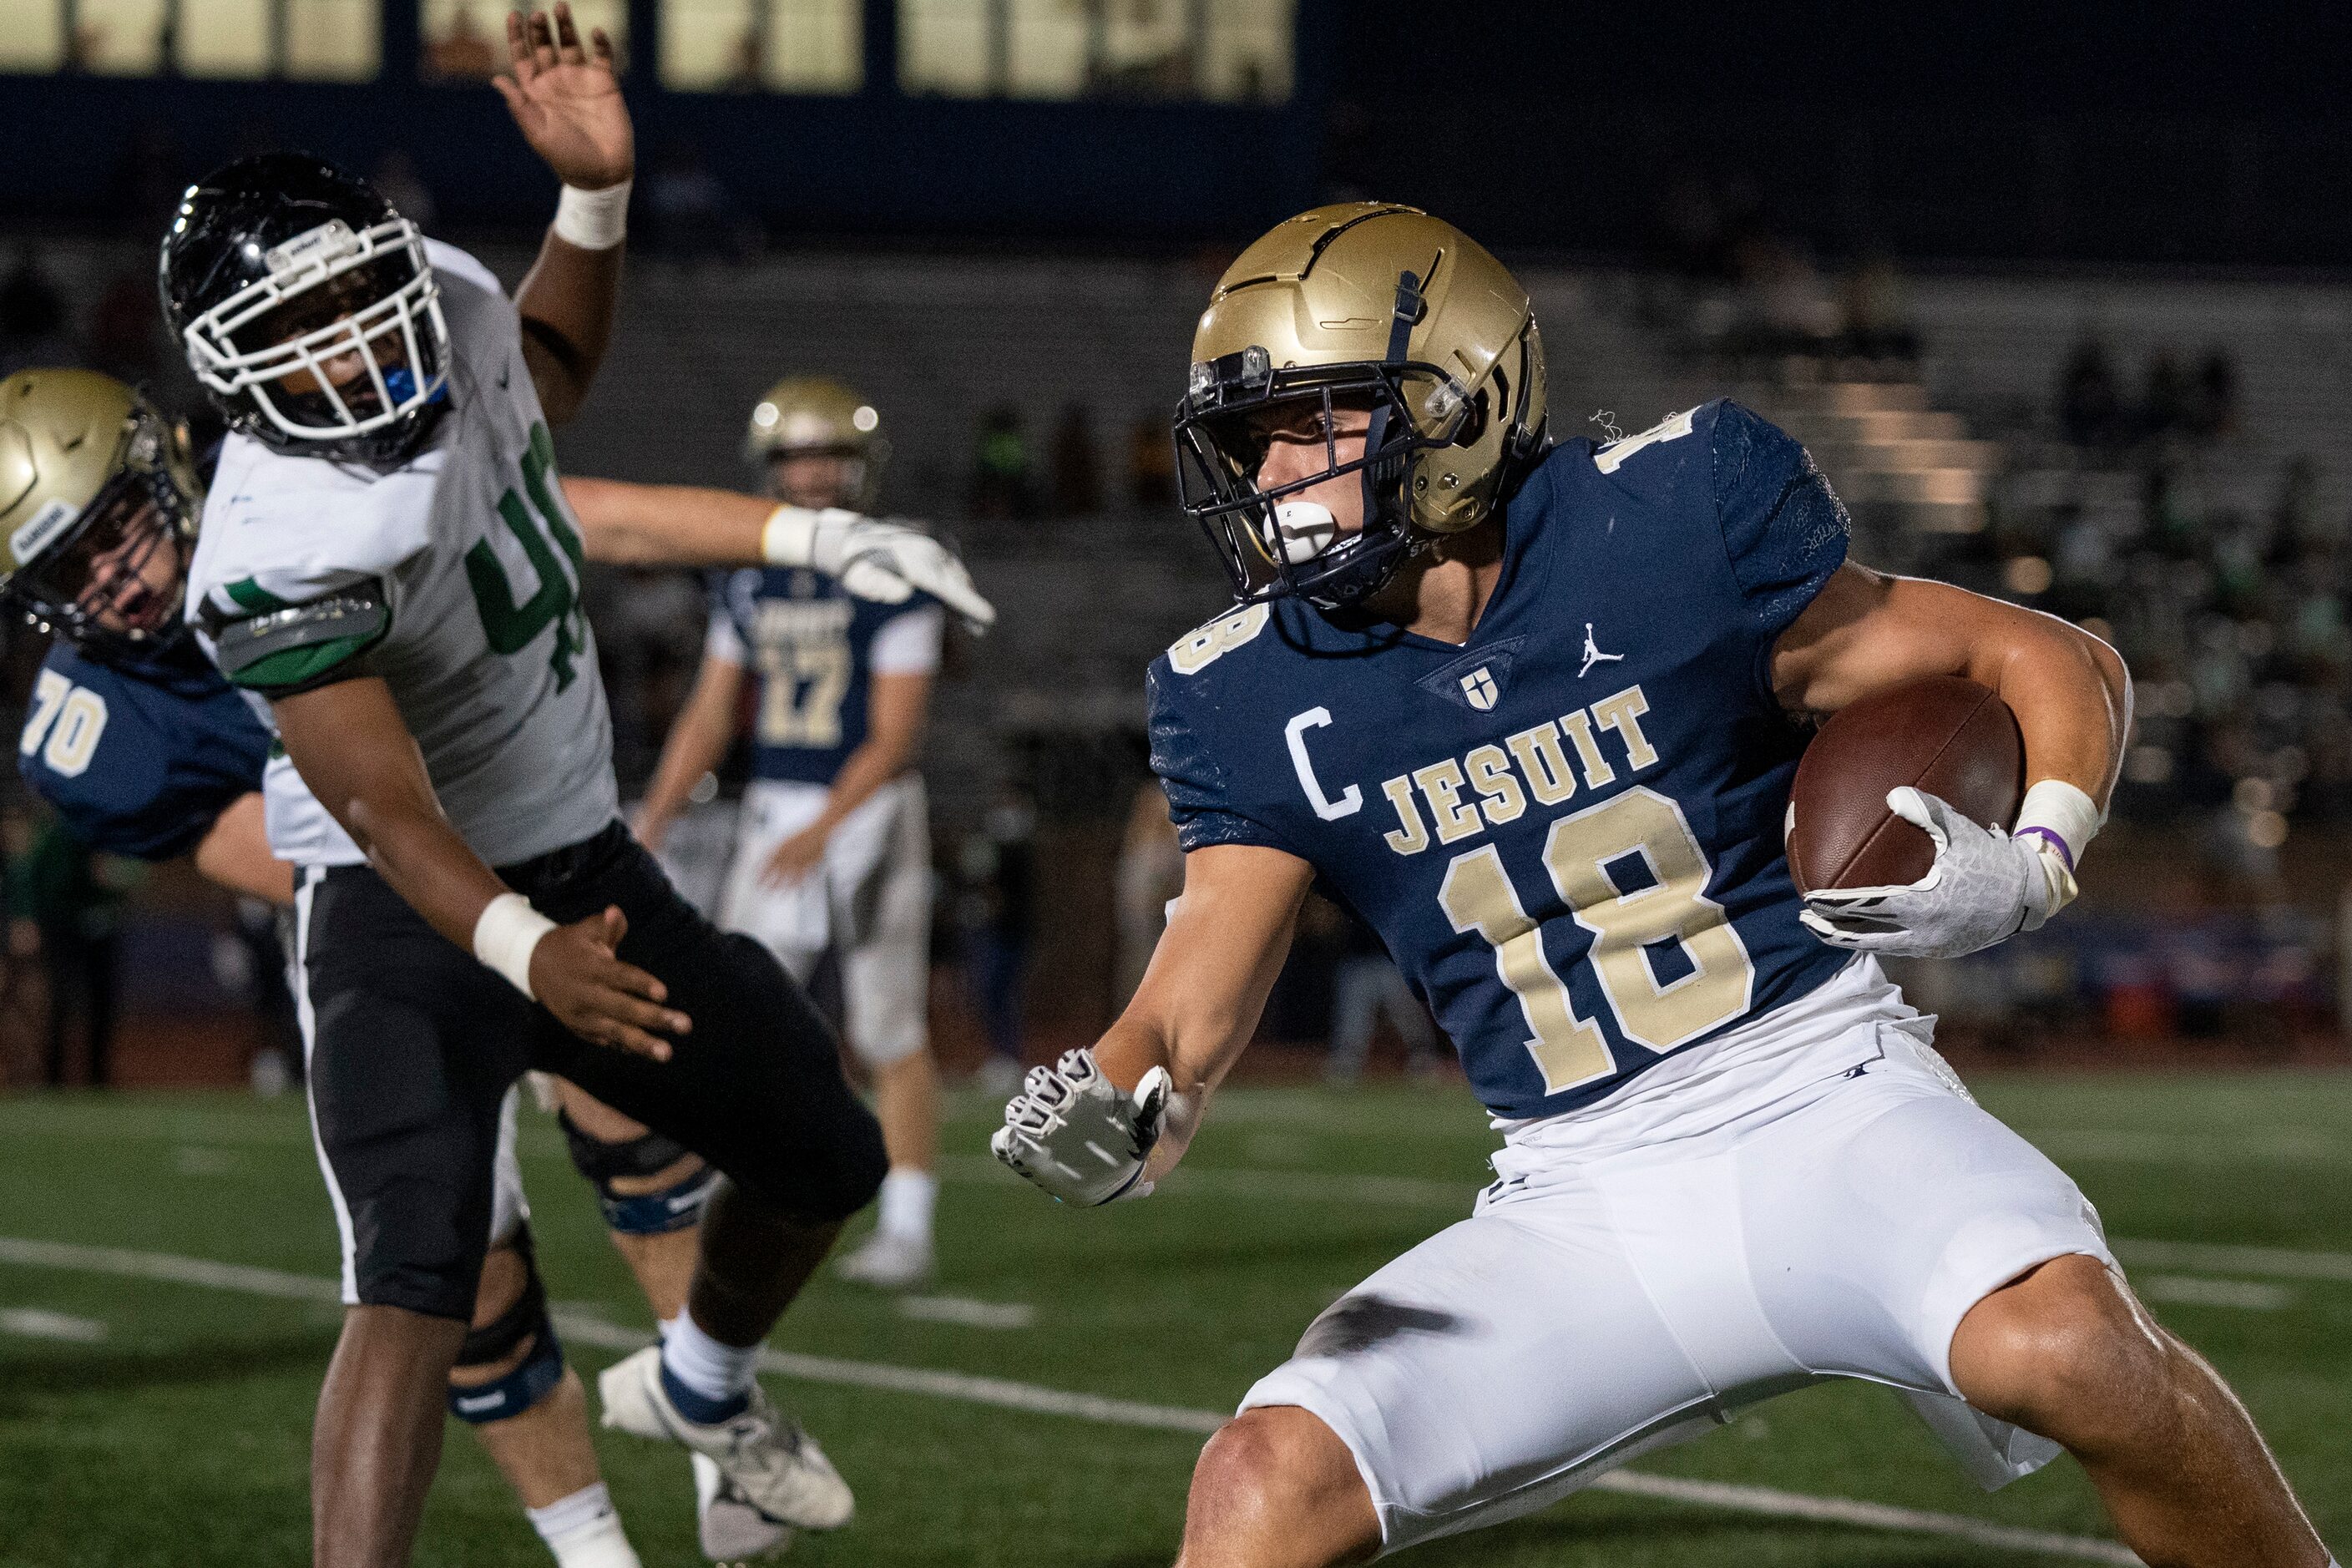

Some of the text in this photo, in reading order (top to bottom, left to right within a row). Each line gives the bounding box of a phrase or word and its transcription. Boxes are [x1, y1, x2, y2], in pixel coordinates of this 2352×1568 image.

[20, 667, 109, 778] 70
[757, 639, 853, 745] 17
[1285, 706, 1363, 821] C
[1381, 685, 1659, 856] JESUIT
[1438, 784, 1755, 1096] 18
